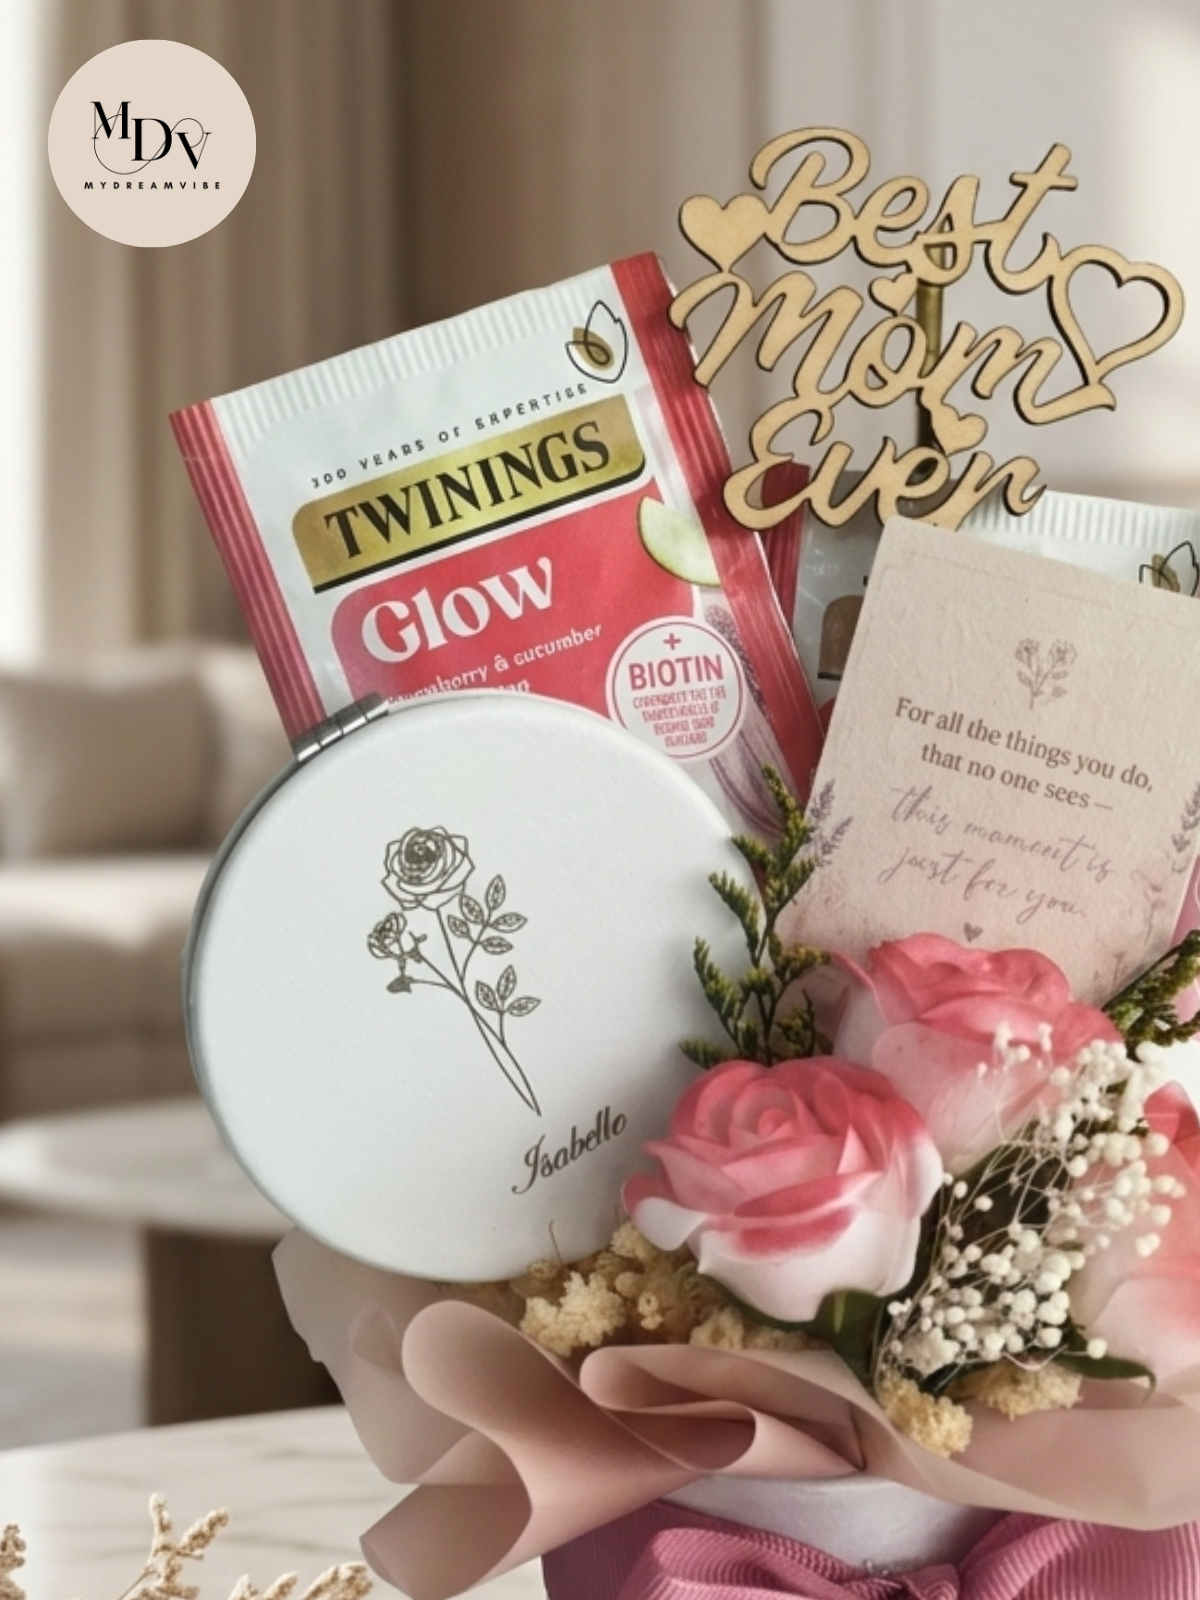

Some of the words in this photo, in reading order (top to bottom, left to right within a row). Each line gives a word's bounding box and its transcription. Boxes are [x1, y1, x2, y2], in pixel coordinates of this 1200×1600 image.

[748, 126, 1078, 296] Best
[669, 270, 1116, 425] Mom
[358, 438, 425, 470] YEARS
[438, 426, 459, 443] OF
[324, 421, 610, 559] TWININGS
[360, 556, 553, 663] Glow
[513, 624, 602, 666] cucumber
[628, 654, 724, 691] BIOTIN
[894, 696, 935, 726] For
[935, 711, 964, 735] all
[966, 718, 1002, 747] the
[1005, 729, 1072, 769] things
[1073, 754, 1116, 780] you
[1120, 763, 1153, 793] do,
[920, 742, 964, 773] that
[966, 757, 997, 781] no
[1000, 769, 1040, 795] one
[1043, 782, 1090, 809] sees
[962, 857, 1019, 901] for
[1085, 851, 1116, 883] is
